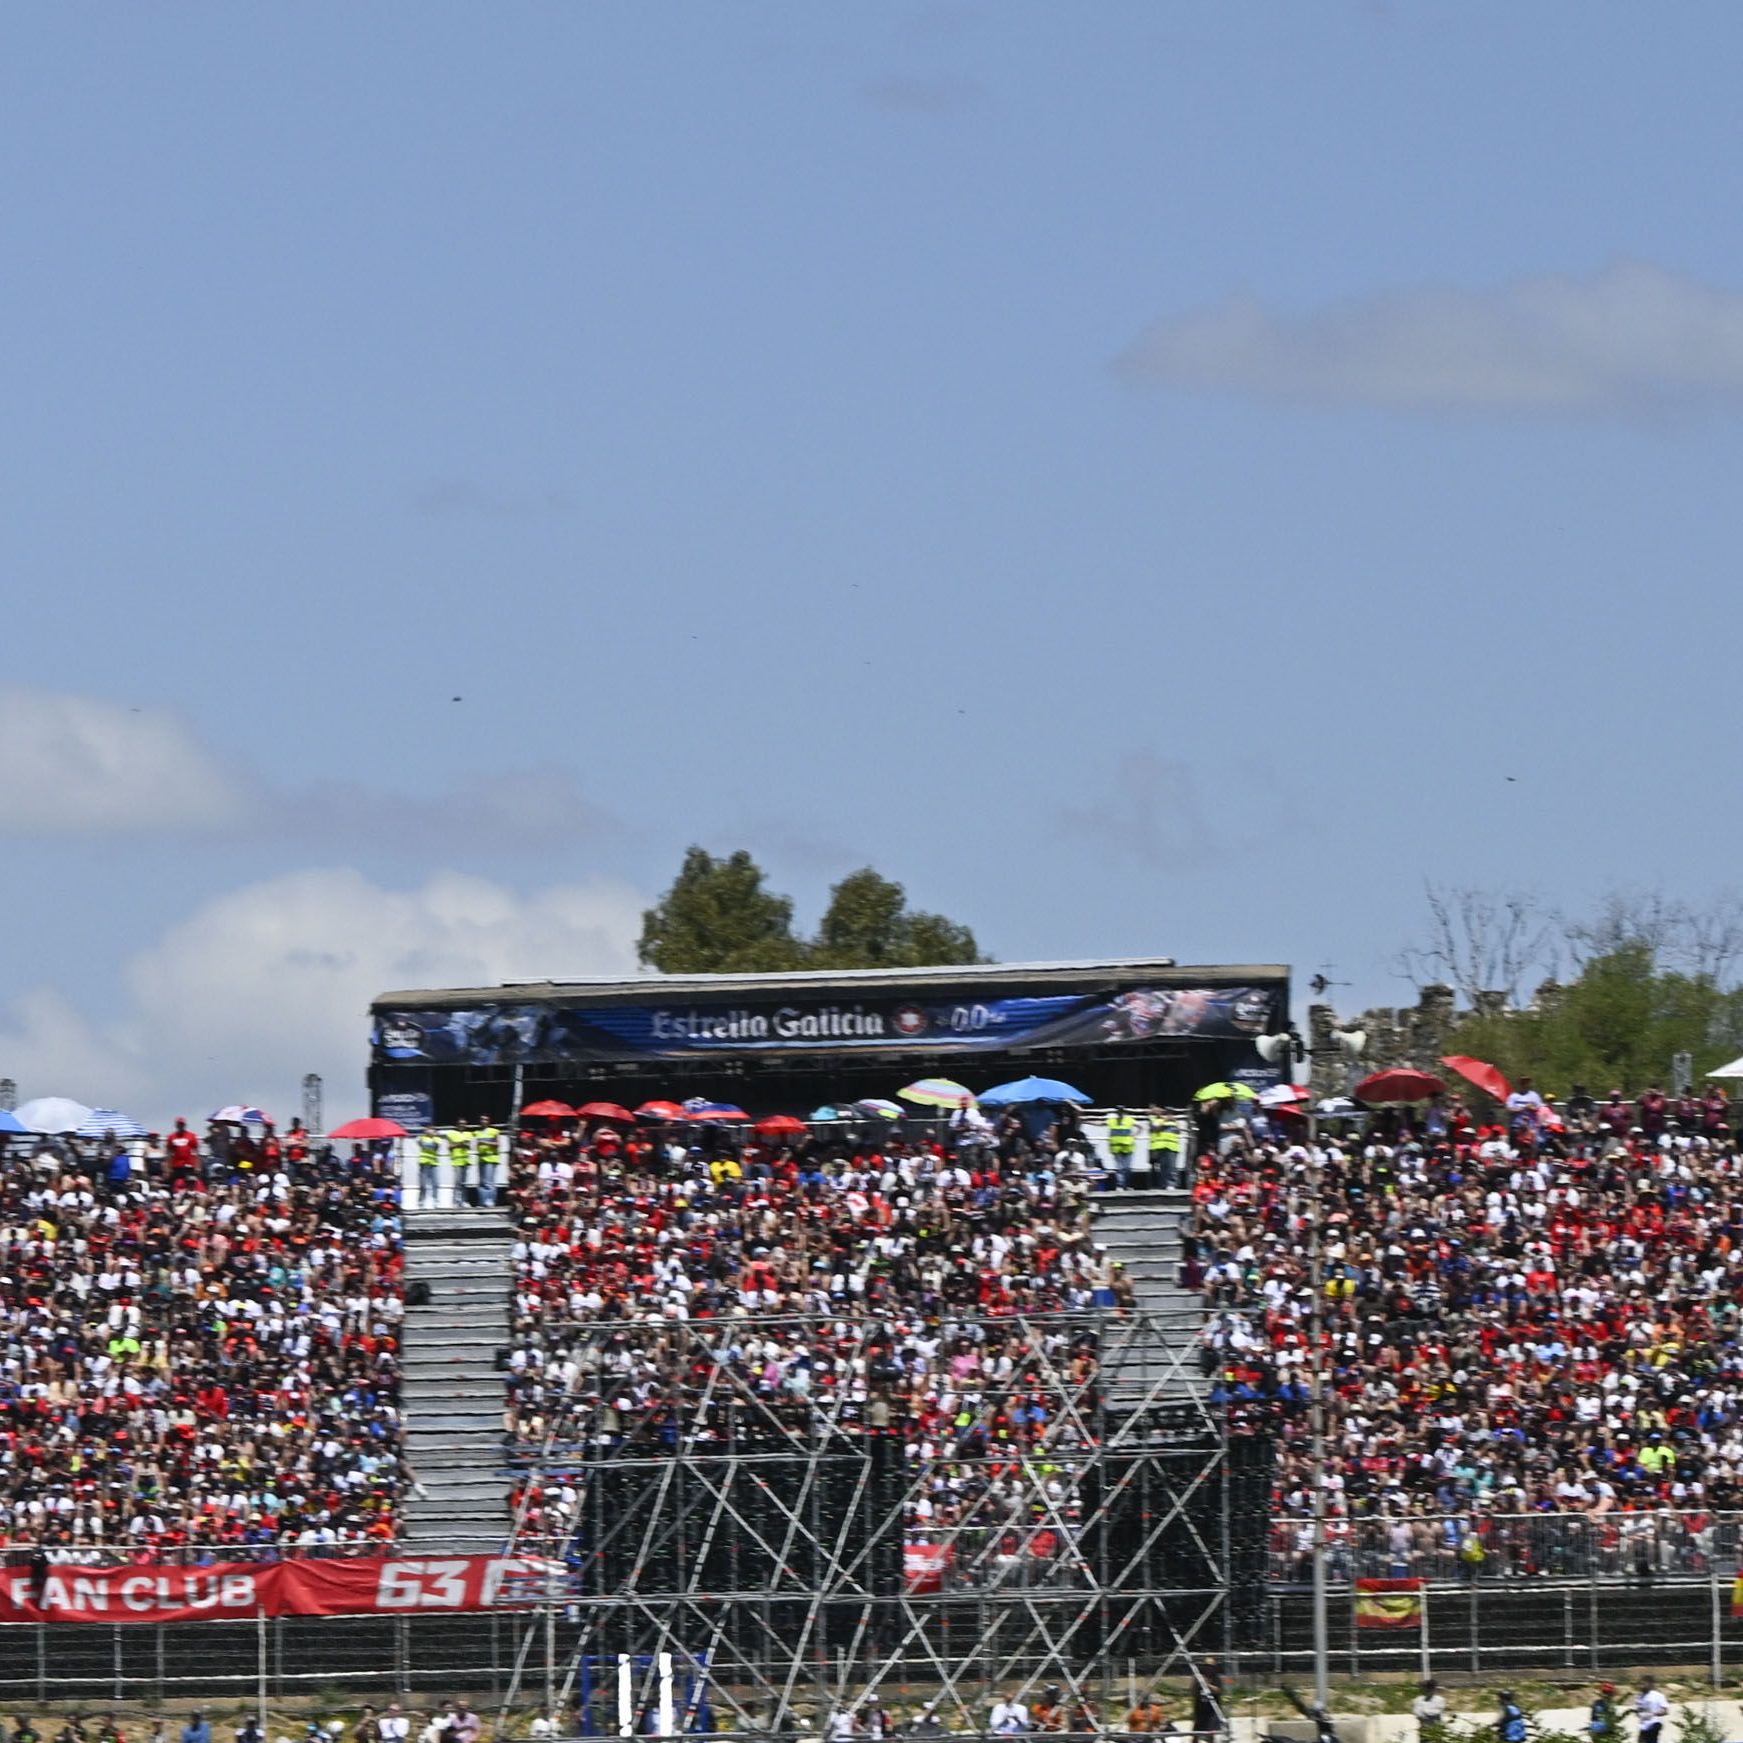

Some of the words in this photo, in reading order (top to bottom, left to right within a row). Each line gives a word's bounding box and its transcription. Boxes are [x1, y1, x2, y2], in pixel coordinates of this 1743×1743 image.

[652, 1010, 769, 1038] Estrella
[772, 1006, 885, 1038] Galicia
[11, 1577, 109, 1613] FAN
[122, 1574, 255, 1611] CLUB
